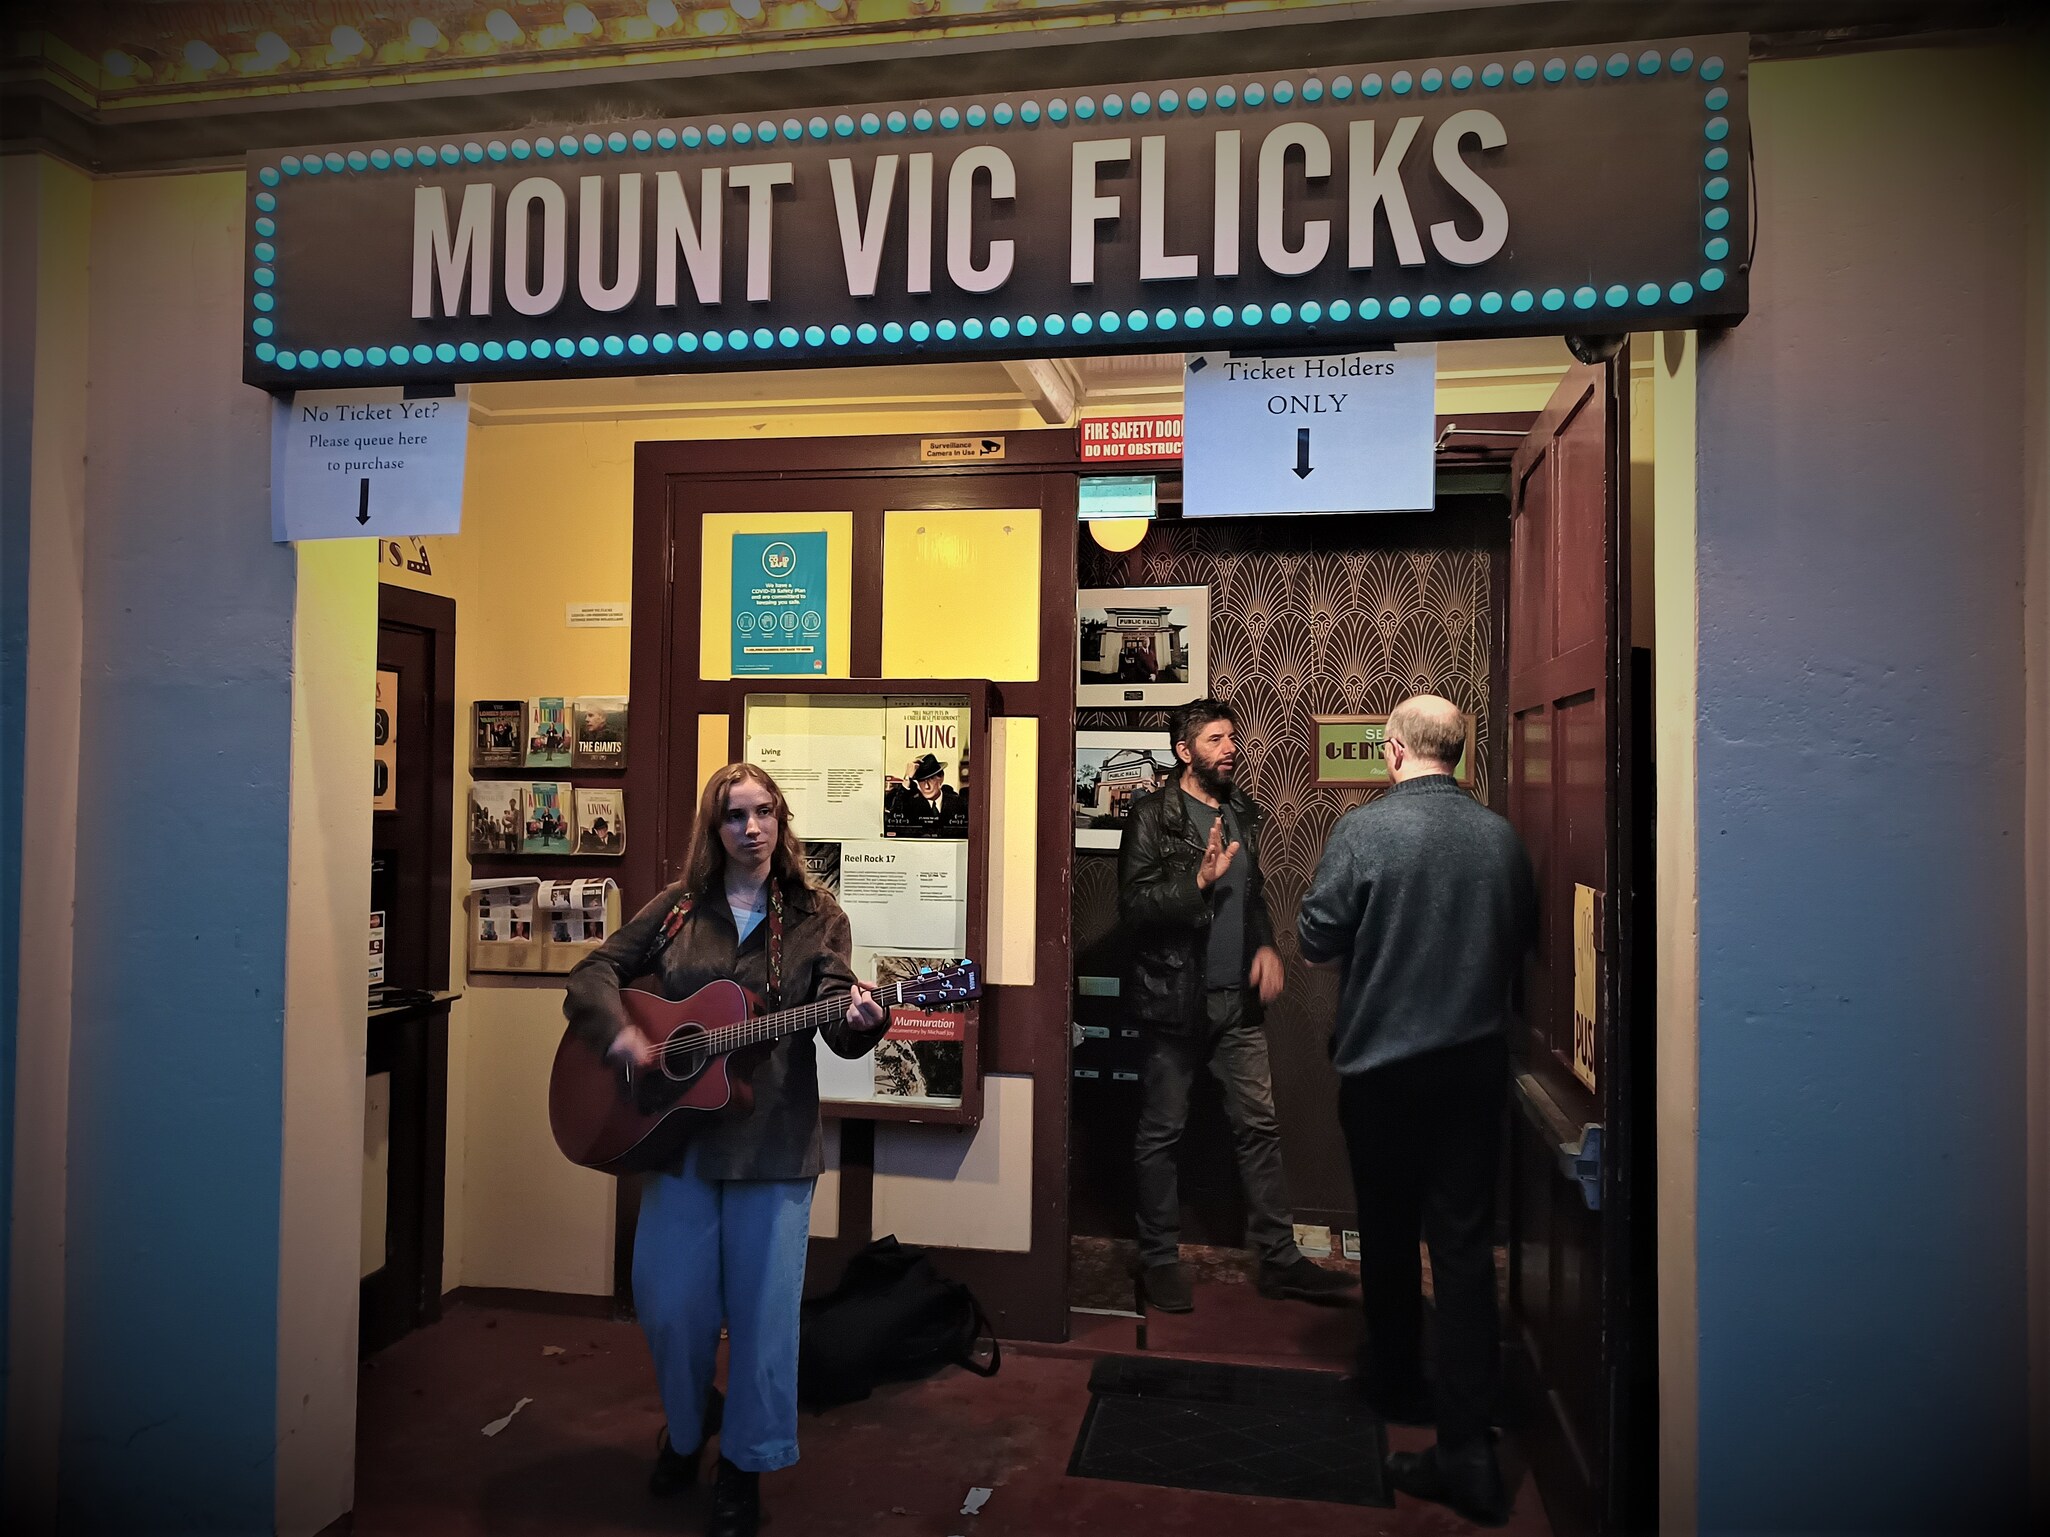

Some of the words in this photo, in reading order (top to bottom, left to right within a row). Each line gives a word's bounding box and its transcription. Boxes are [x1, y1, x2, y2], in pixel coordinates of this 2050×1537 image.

[411, 161, 795, 320] MOUNT
[829, 144, 1016, 299] VIC
[1070, 109, 1510, 286] FLICKS
[1223, 359, 1295, 381] Ticket
[1304, 356, 1395, 378] Holders
[302, 405, 329, 423] No
[336, 403, 393, 421] Ticket
[400, 401, 440, 420] Yet?
[1267, 393, 1348, 415] ONLY
[1084, 422, 1110, 441] FIRE
[1111, 420, 1154, 440] SAFETY
[309, 434, 350, 448] Please
[354, 436, 394, 450] queue
[399, 431, 428, 446] here
[930, 441, 972, 450] Surveillance
[1084, 444, 1101, 457] DO
[1103, 443, 1126, 456] NOT
[1128, 441, 1184, 455] OBSTRUC
[926, 450, 953, 458] Camera
[962, 449, 976, 457] Use
[327, 459, 341, 471] to
[344, 456, 405, 475] purchase
[905, 725, 956, 749] LIVING
[578, 741, 594, 752] THE
[594, 741, 622, 753] GIANTS
[761, 748, 781, 756] Living
[587, 803, 612, 815] LIVING
[844, 854, 862, 863] Reel
[864, 854, 884, 863] Rock
[886, 855, 896, 863] 17
[893, 1016, 955, 1029] Murmuration
